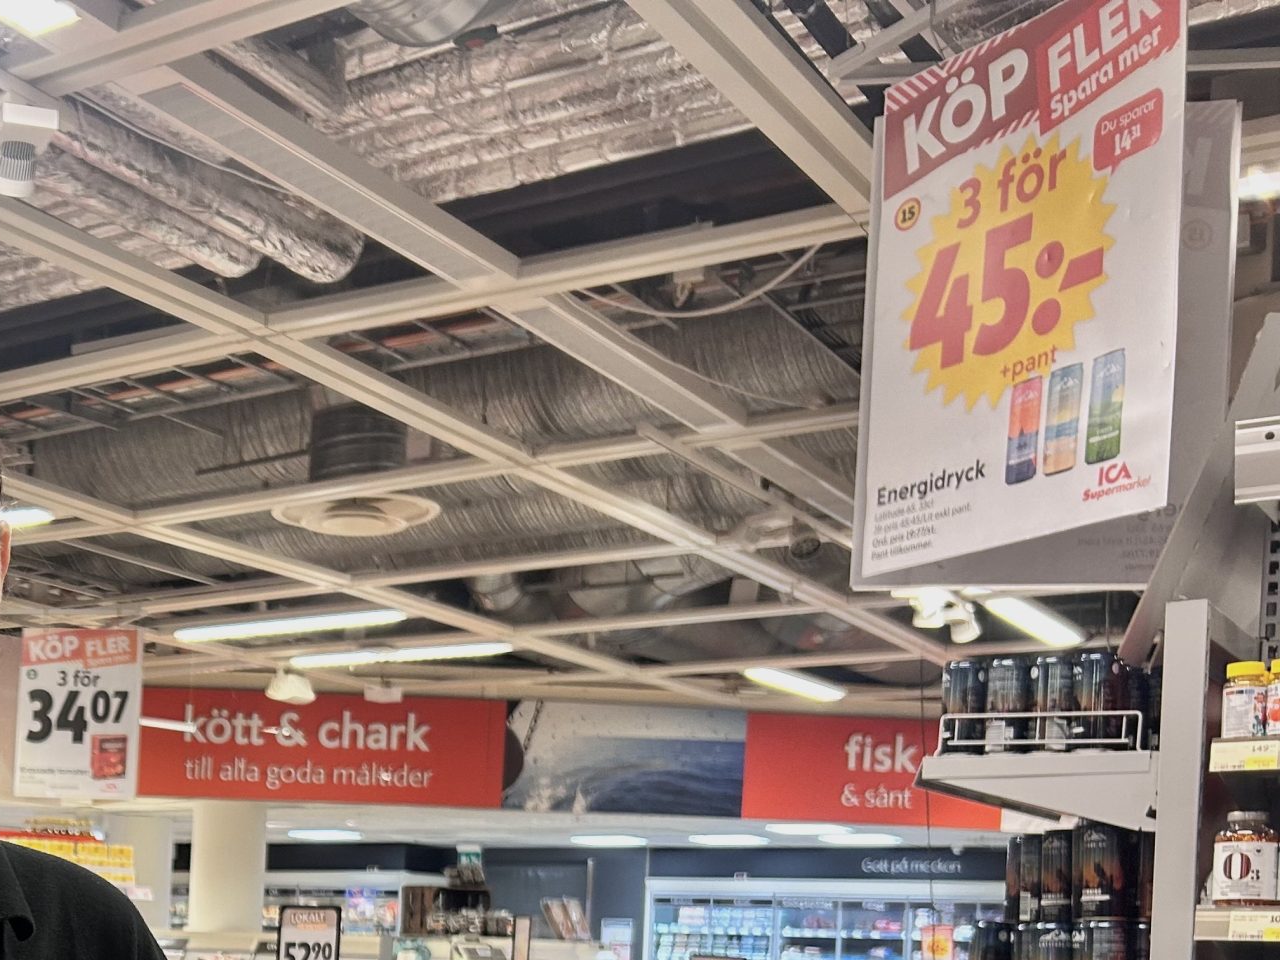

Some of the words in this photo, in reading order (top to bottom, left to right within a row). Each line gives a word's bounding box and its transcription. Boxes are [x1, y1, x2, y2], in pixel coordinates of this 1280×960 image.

[1050, 62, 1114, 120] Spara
[1118, 25, 1162, 72] mer
[903, 48, 1029, 175] KÖP
[1101, 117, 1118, 136] Du
[1119, 98, 1157, 127] sparar
[957, 177, 981, 229] 3
[998, 147, 1066, 212] för
[900, 206, 916, 223] 15
[1000, 344, 1058, 381] +pant
[877, 459, 985, 506] Energidryck
[1082, 475, 1151, 501] Supermarket
[1098, 461, 1131, 487] ICA
[28, 635, 79, 662] KÖP
[84, 636, 131, 658] FLER
[57, 670, 68, 687] 3
[73, 670, 101, 687] för
[26, 688, 129, 744] 3407
[183, 704, 264, 746] kött
[275, 711, 309, 747] &
[318, 710, 431, 753] chark
[844, 733, 918, 775] fisk
[184, 756, 213, 781] till
[219, 757, 260, 783] alla
[265, 757, 325, 790] goda
[333, 761, 433, 789] måltider
[841, 784, 860, 807] &
[864, 782, 913, 809] sånt
[861, 857, 889, 874] Gott
[890, 857, 908, 875] på
[291, 911, 326, 925] LOKALT
